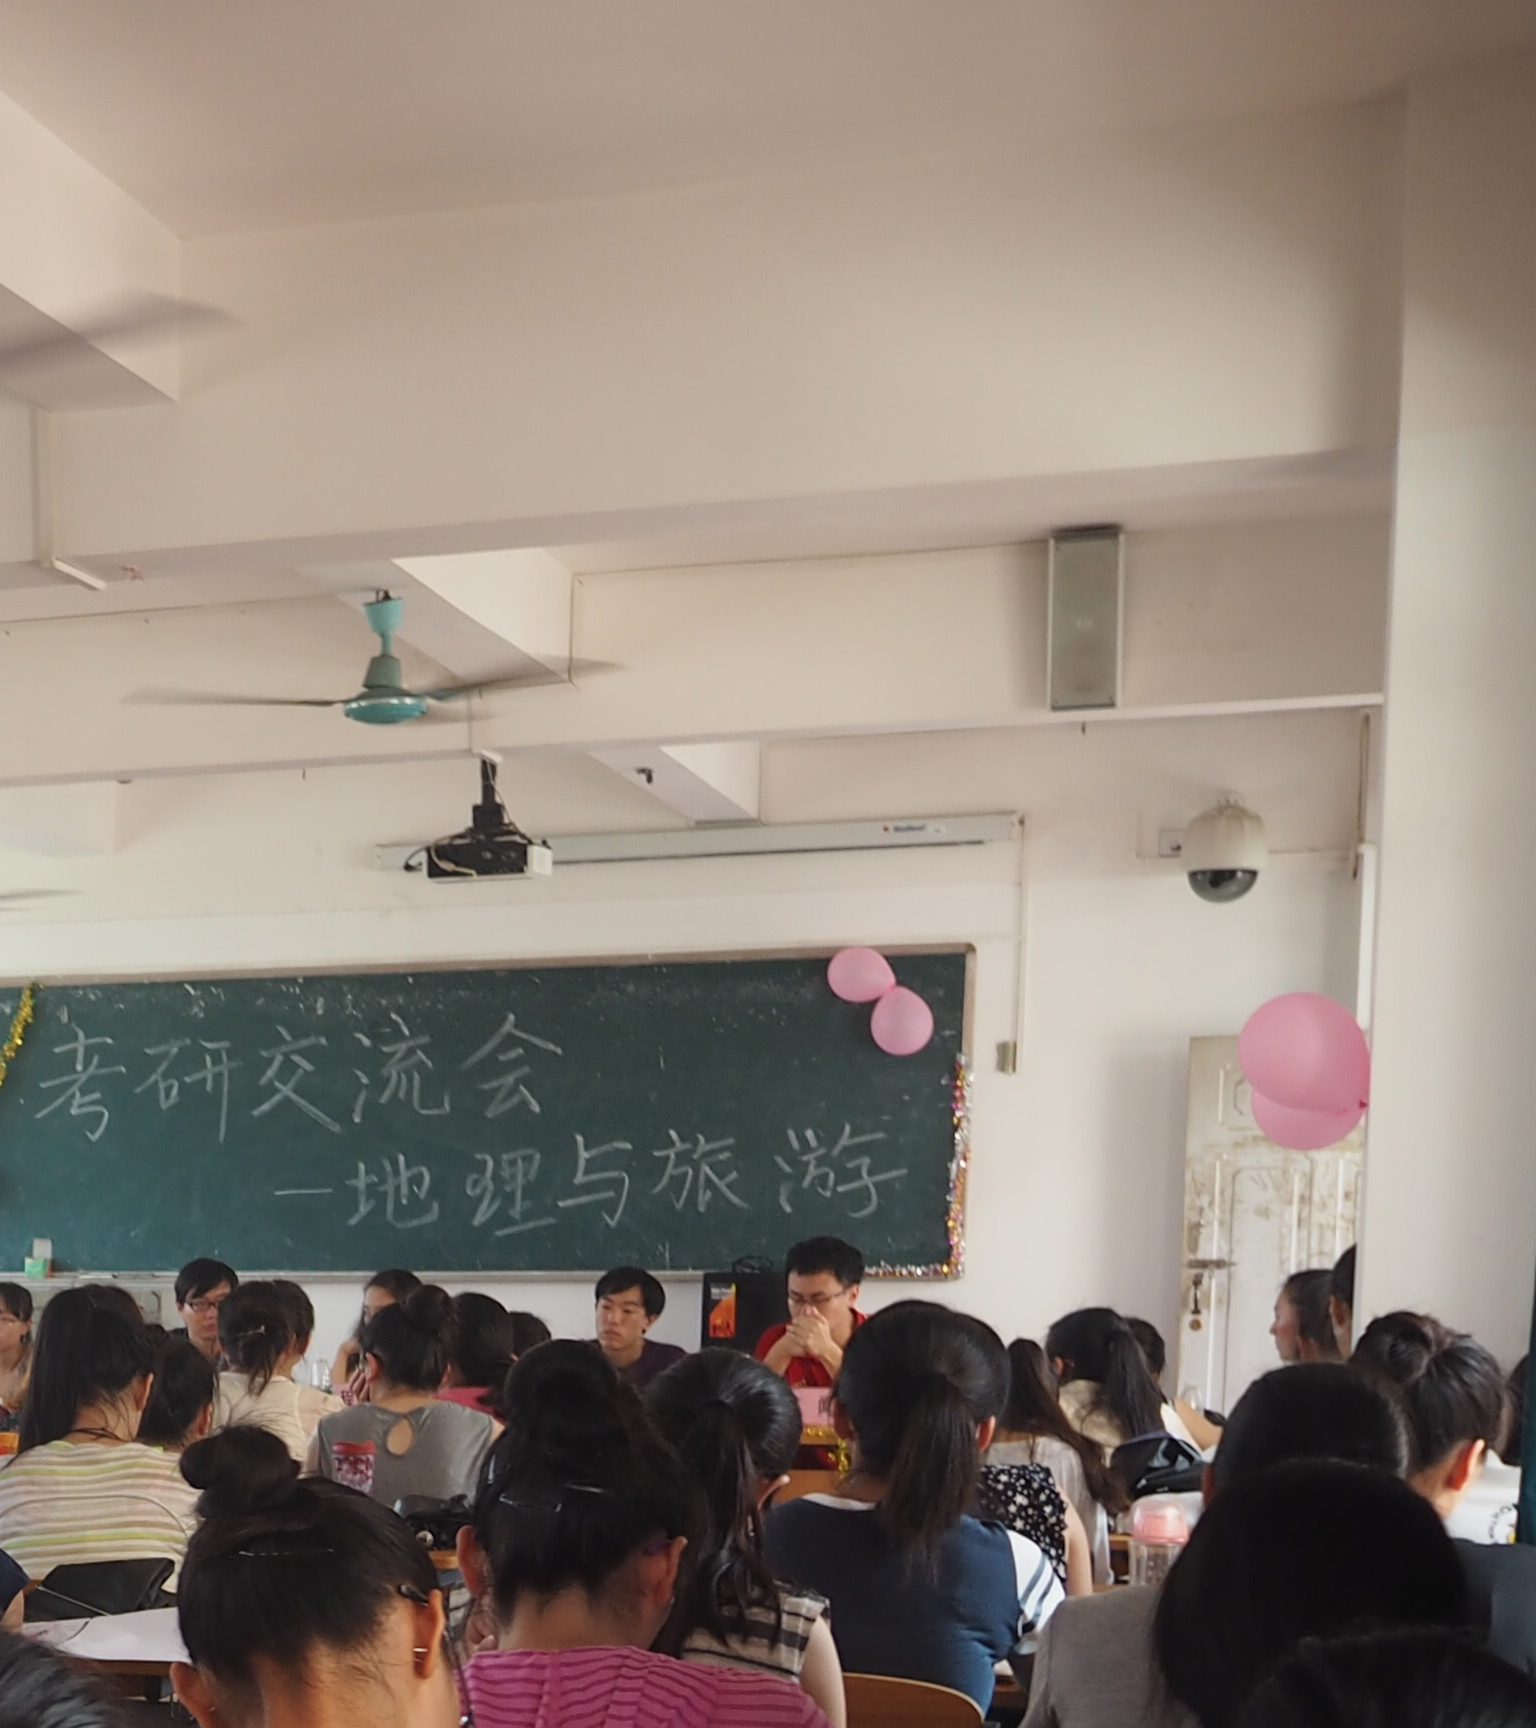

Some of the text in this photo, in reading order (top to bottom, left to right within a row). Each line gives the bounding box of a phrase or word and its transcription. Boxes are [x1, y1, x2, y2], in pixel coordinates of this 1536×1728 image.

[36, 1012, 563, 1142] 考研交流会
